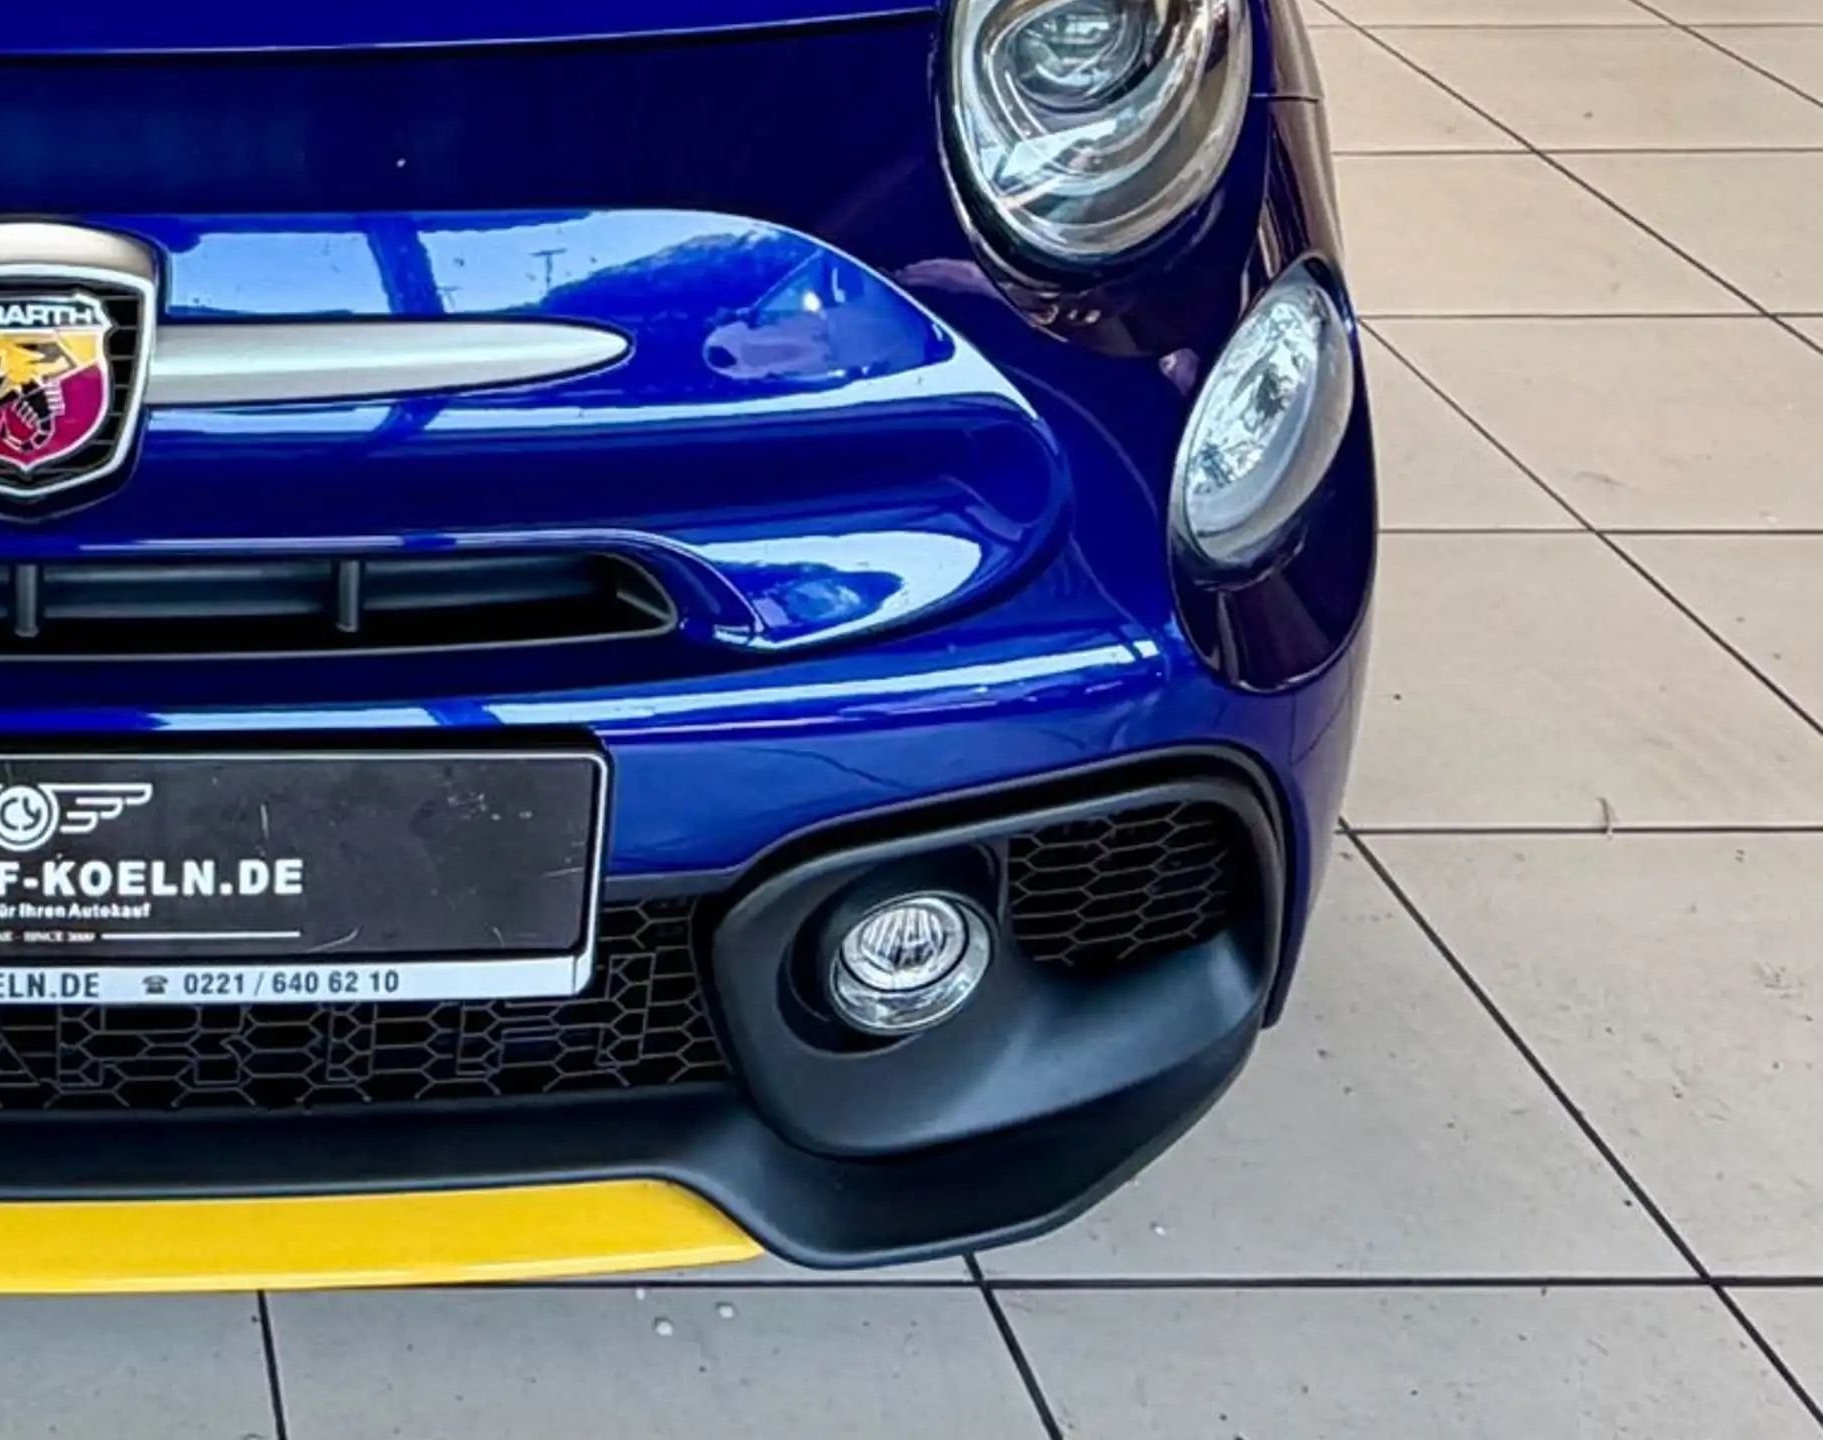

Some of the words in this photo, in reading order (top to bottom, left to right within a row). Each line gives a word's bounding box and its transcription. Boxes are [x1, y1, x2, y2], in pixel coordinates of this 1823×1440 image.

[18, 901, 66, 919] Ihren
[67, 900, 152, 919] Autokauf
[182, 971, 245, 995] 0221
[271, 970, 320, 994] 640
[327, 970, 360, 994] 62
[368, 969, 400, 993] 10
